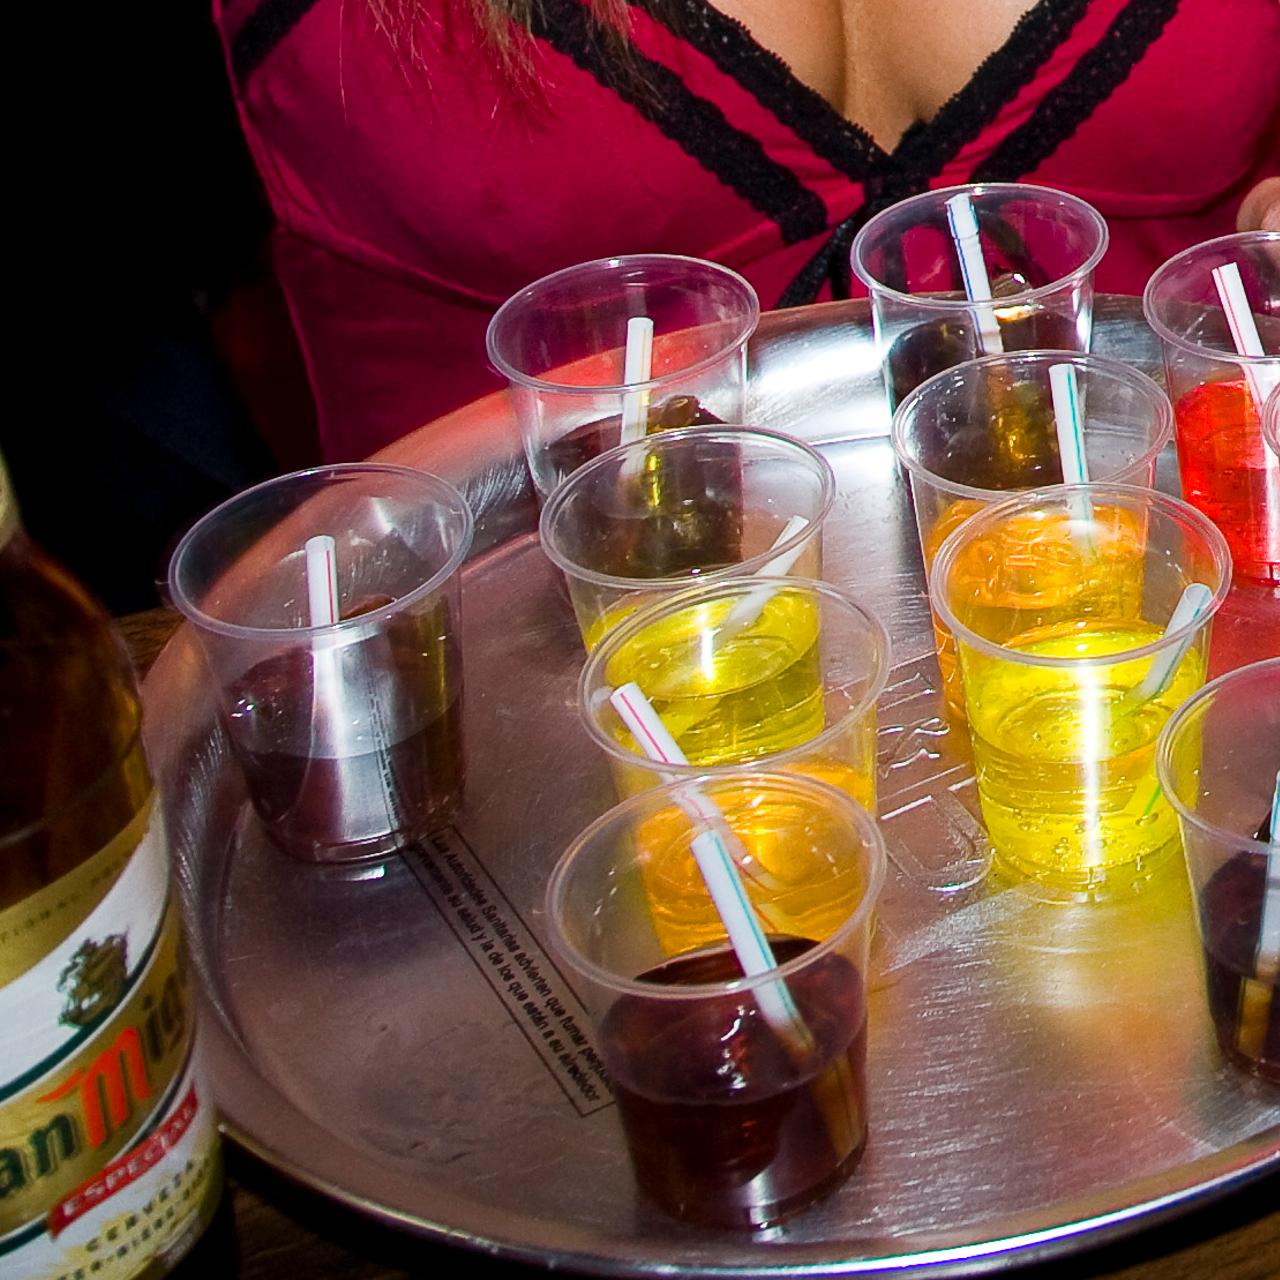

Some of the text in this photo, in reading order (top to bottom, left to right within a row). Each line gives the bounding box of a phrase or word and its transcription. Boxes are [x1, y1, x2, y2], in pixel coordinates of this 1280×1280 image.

[457, 907, 483, 933] salud
[497, 963, 514, 981] los
[507, 981, 527, 1001] que
[482, 905, 519, 952] Sanitarias
[514, 952, 551, 996] advierten
[545, 996, 565, 1017] que
[559, 1015, 587, 1046] fumar
